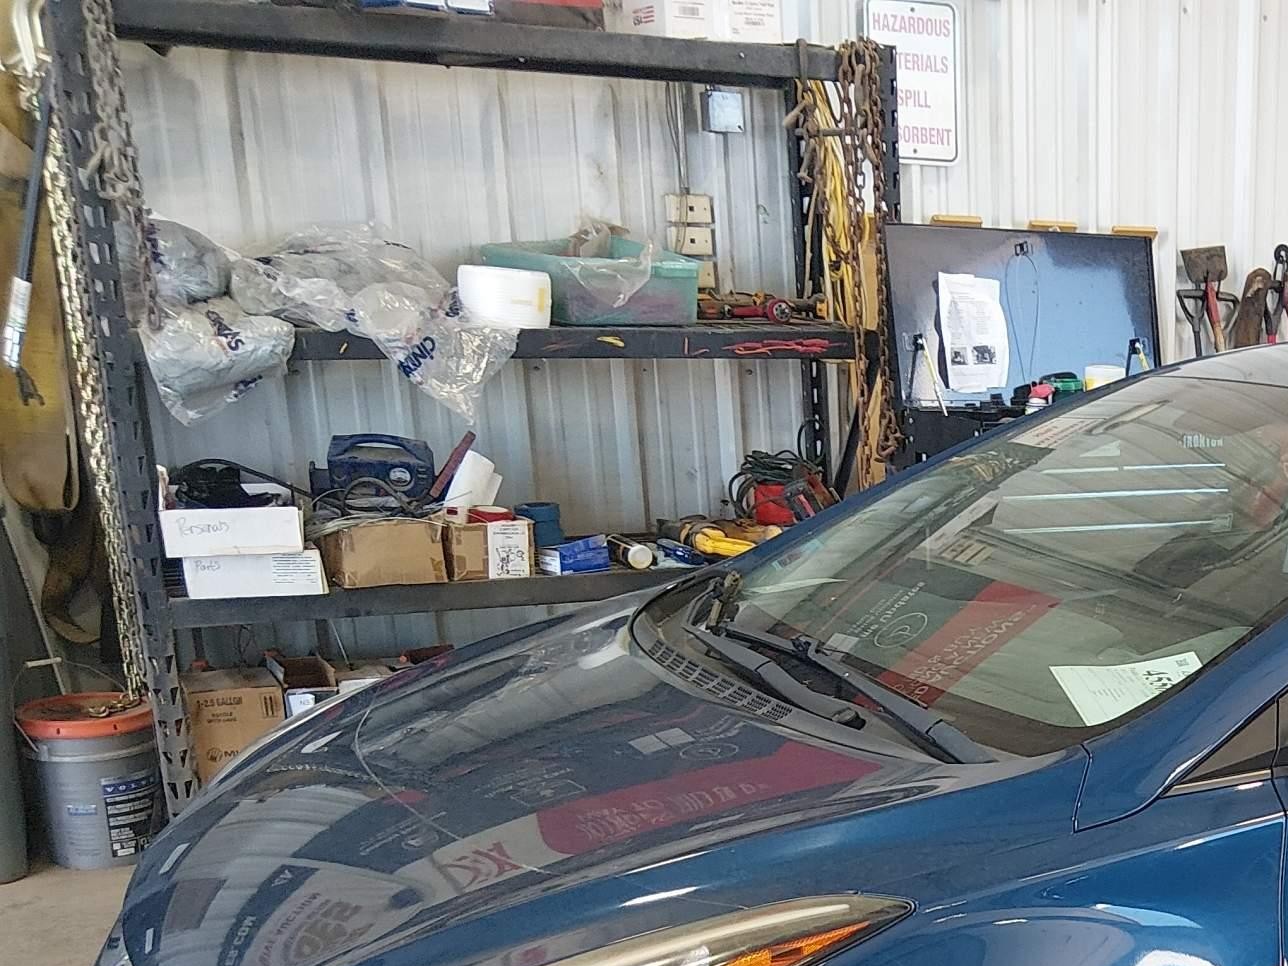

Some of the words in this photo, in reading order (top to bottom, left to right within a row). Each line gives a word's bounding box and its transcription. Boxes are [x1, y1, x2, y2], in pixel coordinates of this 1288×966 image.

[872, 12, 951, 38] HAZARDOUS
[896, 51, 949, 74] TERIALS
[897, 89, 931, 109] SPILL
[898, 125, 953, 147] SORBENT
